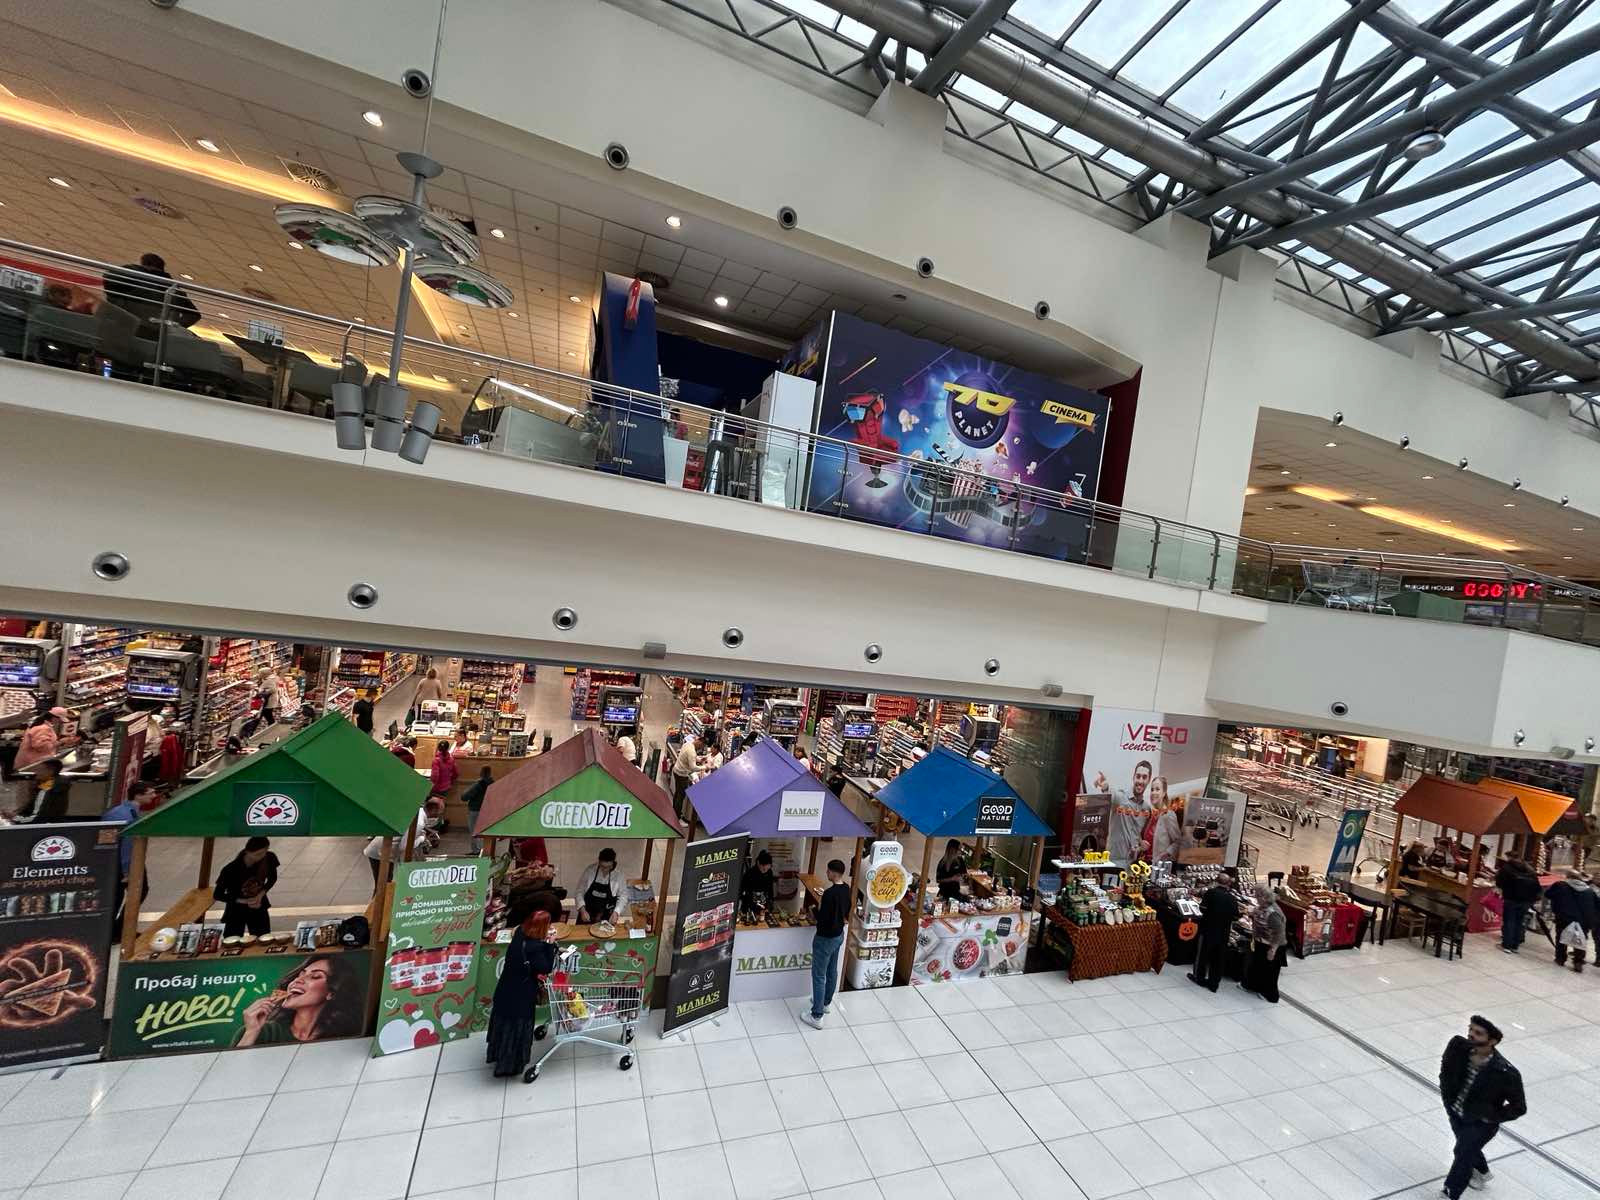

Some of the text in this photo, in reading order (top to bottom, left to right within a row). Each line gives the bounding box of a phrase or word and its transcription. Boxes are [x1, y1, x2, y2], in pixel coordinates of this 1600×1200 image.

[1049, 405, 1087, 421] CINEMA
[955, 411, 994, 437] PLANET
[1127, 722, 1188, 744] VERO
[1121, 742, 1157, 752] center
[253, 798, 292, 819] VITALIA
[543, 802, 630, 827] GREENDELI
[982, 805, 1013, 815] GOOD
[36, 839, 70, 856] VITALIA
[695, 848, 738, 866] MAMA'S
[12, 866, 88, 878] Elements
[410, 866, 476, 886] GREENDELI
[395, 909, 436, 918] ПРИРОДНО
[444, 904, 473, 913] ВКУСНО
[412, 899, 453, 909] ДОМАШНО,
[737, 953, 813, 971] MAMA'S
[135, 974, 256, 991] Пробај нешто
[135, 987, 245, 1034] НОВО!
[676, 991, 720, 1015] MAMA'S
